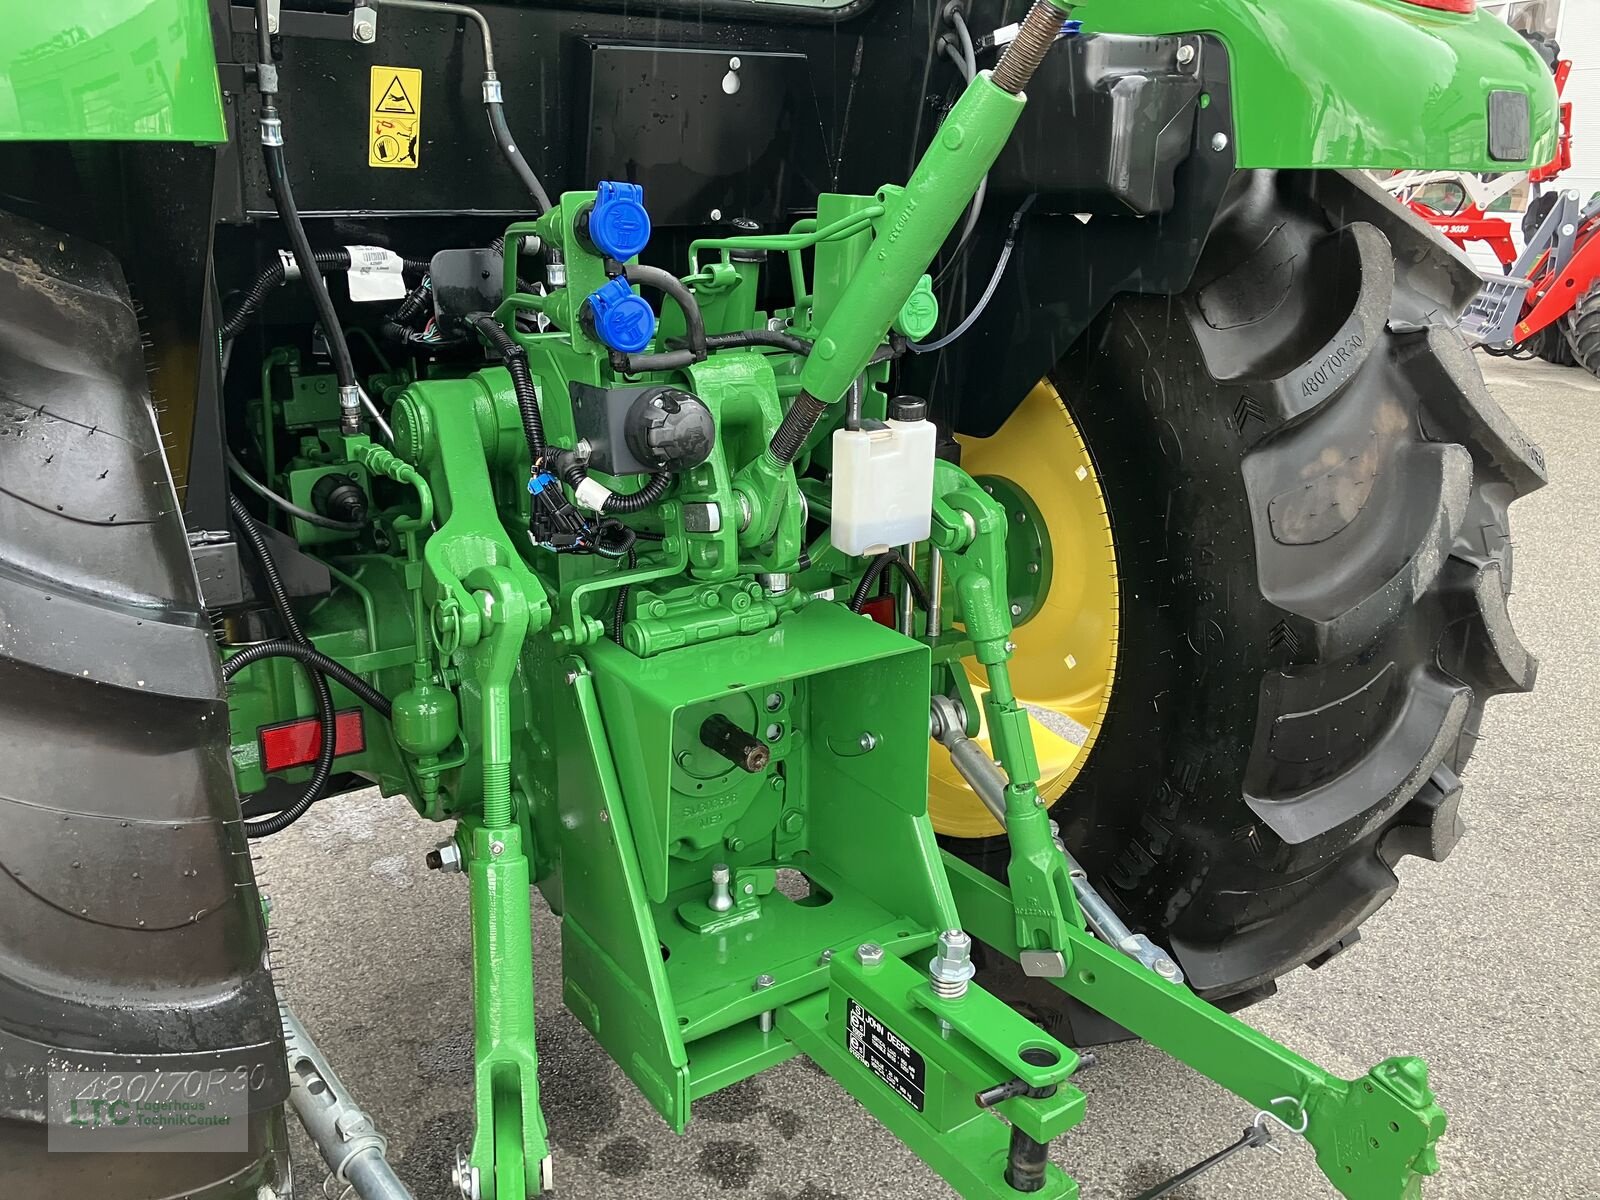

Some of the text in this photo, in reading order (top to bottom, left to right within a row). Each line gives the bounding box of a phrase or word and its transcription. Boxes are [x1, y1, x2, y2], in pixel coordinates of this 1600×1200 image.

[1301, 335, 1363, 397] 480/70R30
[865, 1015, 884, 1036] JOHN
[887, 1032, 911, 1058] DEERE
[75, 1063, 266, 1103] 480/70R30
